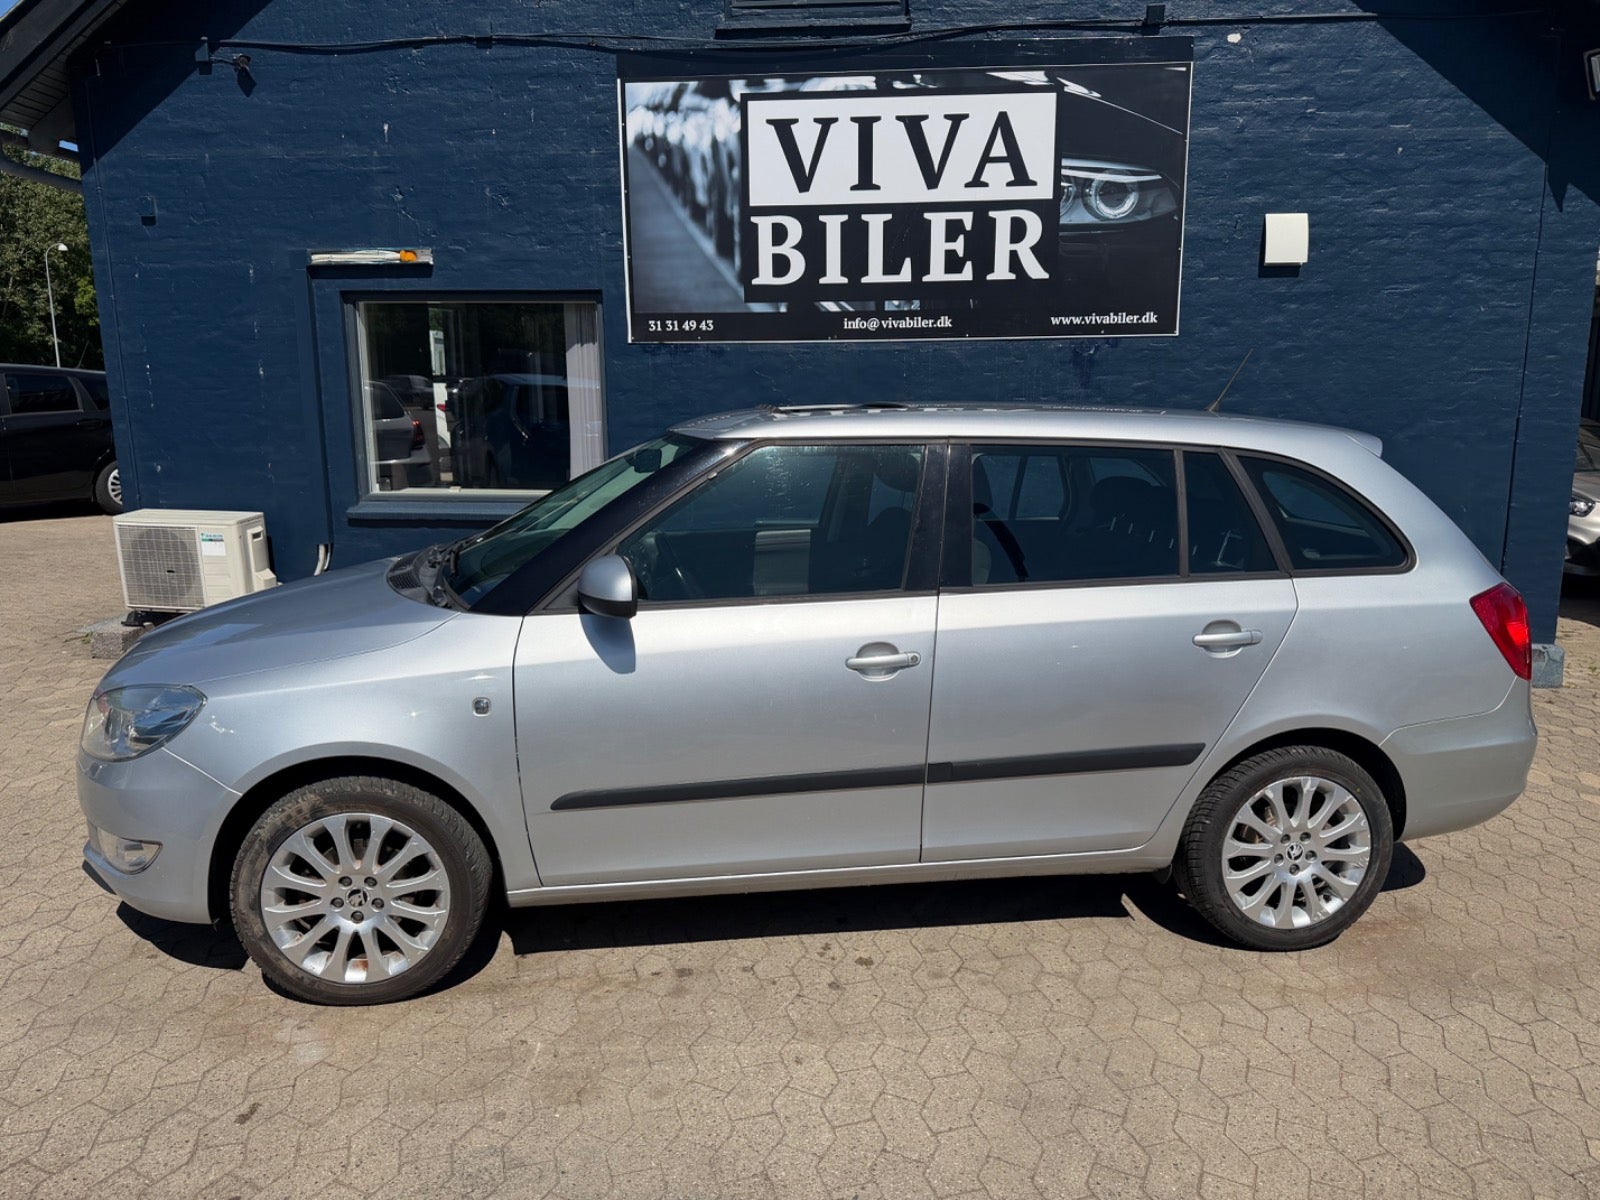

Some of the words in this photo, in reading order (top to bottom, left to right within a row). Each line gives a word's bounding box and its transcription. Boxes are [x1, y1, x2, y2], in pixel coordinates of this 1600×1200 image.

[766, 110, 1038, 194] VIVA
[750, 209, 1050, 285] BILER
[648, 319, 662, 332] 31
[665, 319, 679, 332] 31
[682, 319, 697, 332] 49
[699, 319, 714, 332] 43
[843, 315, 953, 331] info@vivabiler.dk
[1050, 311, 1158, 326] www.vivabiler.dk
